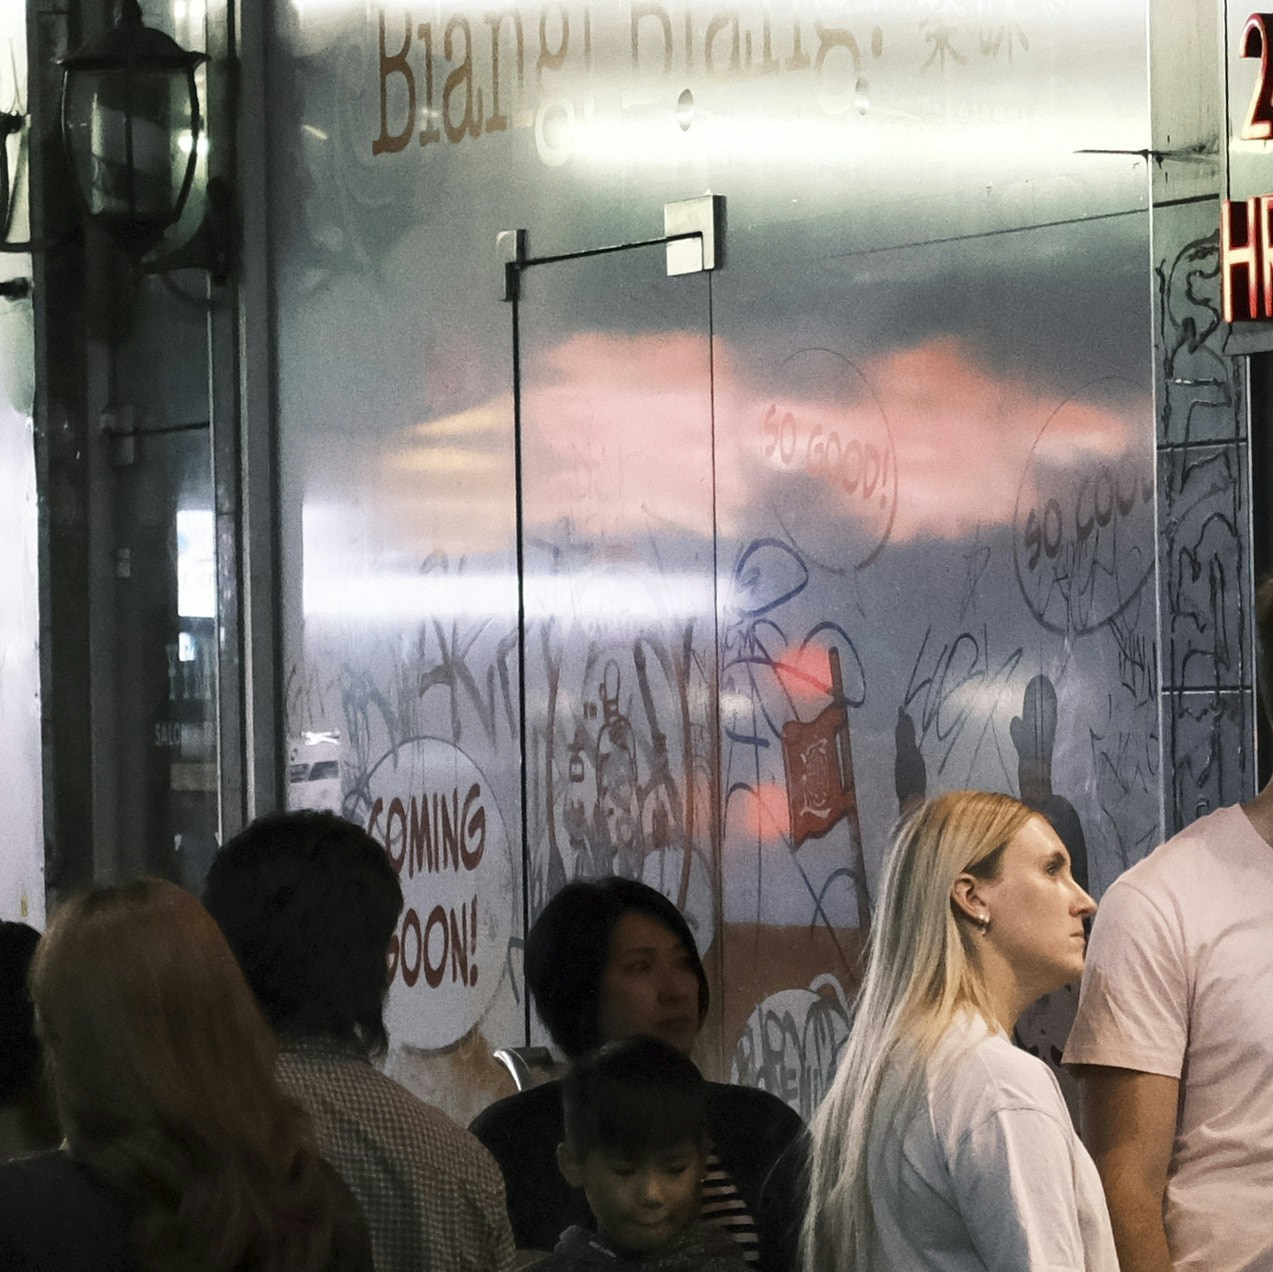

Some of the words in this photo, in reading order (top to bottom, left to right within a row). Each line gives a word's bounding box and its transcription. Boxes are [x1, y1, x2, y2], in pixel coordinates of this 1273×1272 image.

[764, 404, 798, 463] SO
[805, 424, 890, 509] GOOD!
[1024, 498, 1063, 573] SO
